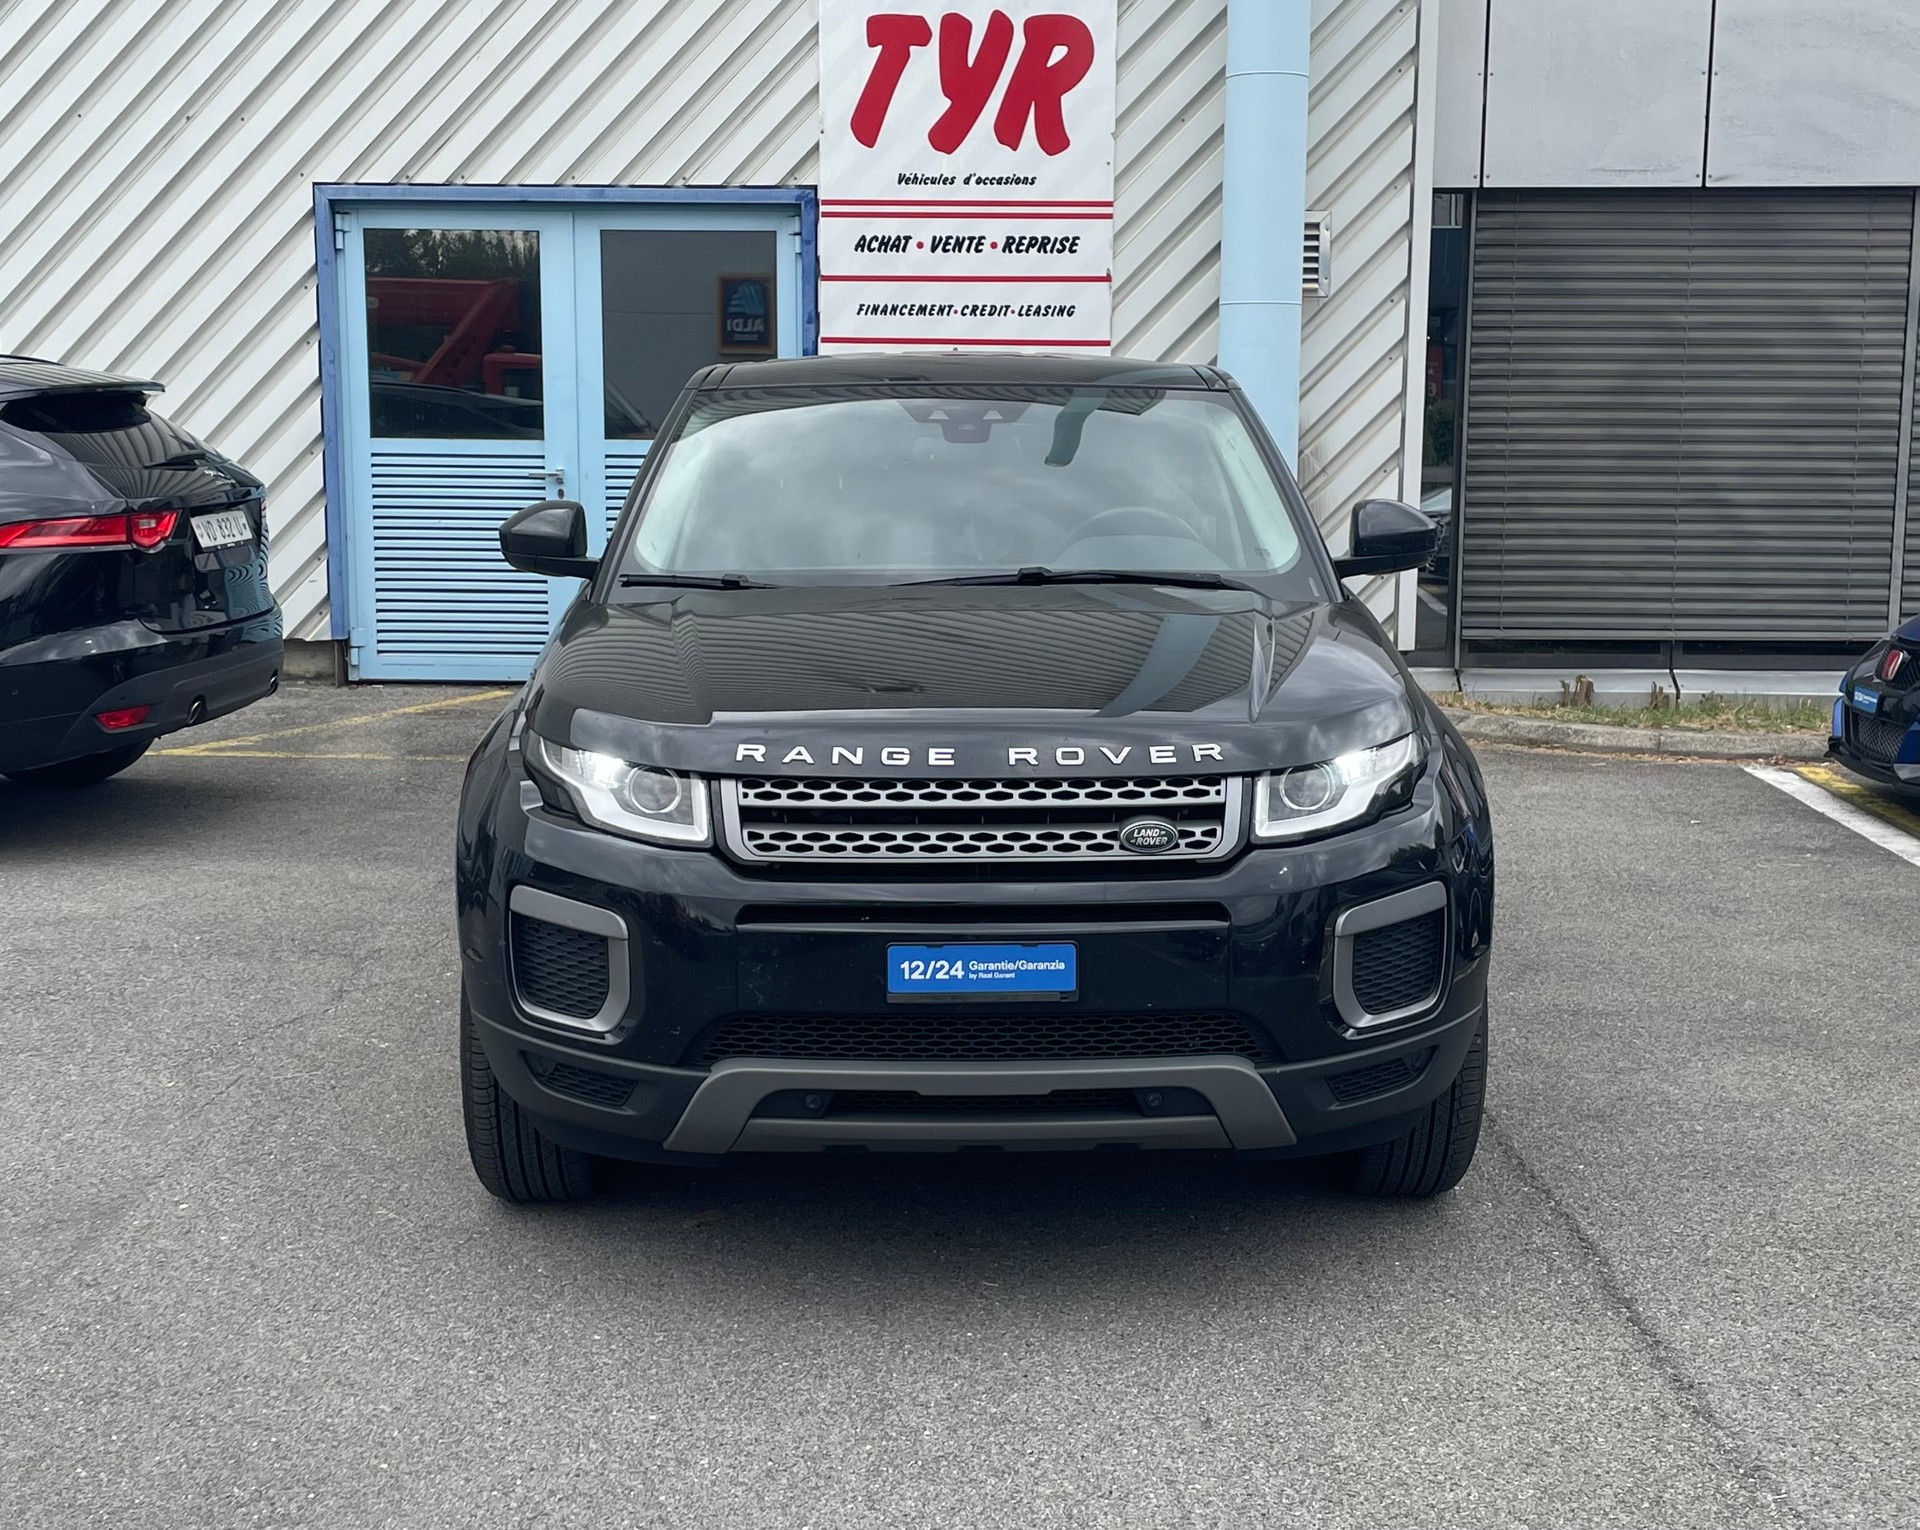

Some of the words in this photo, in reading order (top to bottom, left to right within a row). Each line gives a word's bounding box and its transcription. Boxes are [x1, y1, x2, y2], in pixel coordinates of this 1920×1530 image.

[850, 9, 1095, 156] TYR
[897, 172, 957, 186] Véhicules
[963, 172, 1037, 187] d'occasions
[853, 234, 912, 253] ACHAT
[929, 236, 987, 254] VENTE
[1001, 236, 1081, 255] REPRISE
[856, 303, 954, 317] FINANCEMENT
[960, 304, 1012, 317] CREDIT
[1017, 304, 1076, 318] LEASING
[735, 744, 956, 767] RANGE
[1008, 743, 1224, 766] ROVER
[1133, 828, 1160, 838] LAND
[1135, 836, 1168, 845] ROVER
[900, 960, 965, 980] 12/24
[968, 959, 1066, 971] Garantie/Garanzia
[968, 972, 978, 980] by
